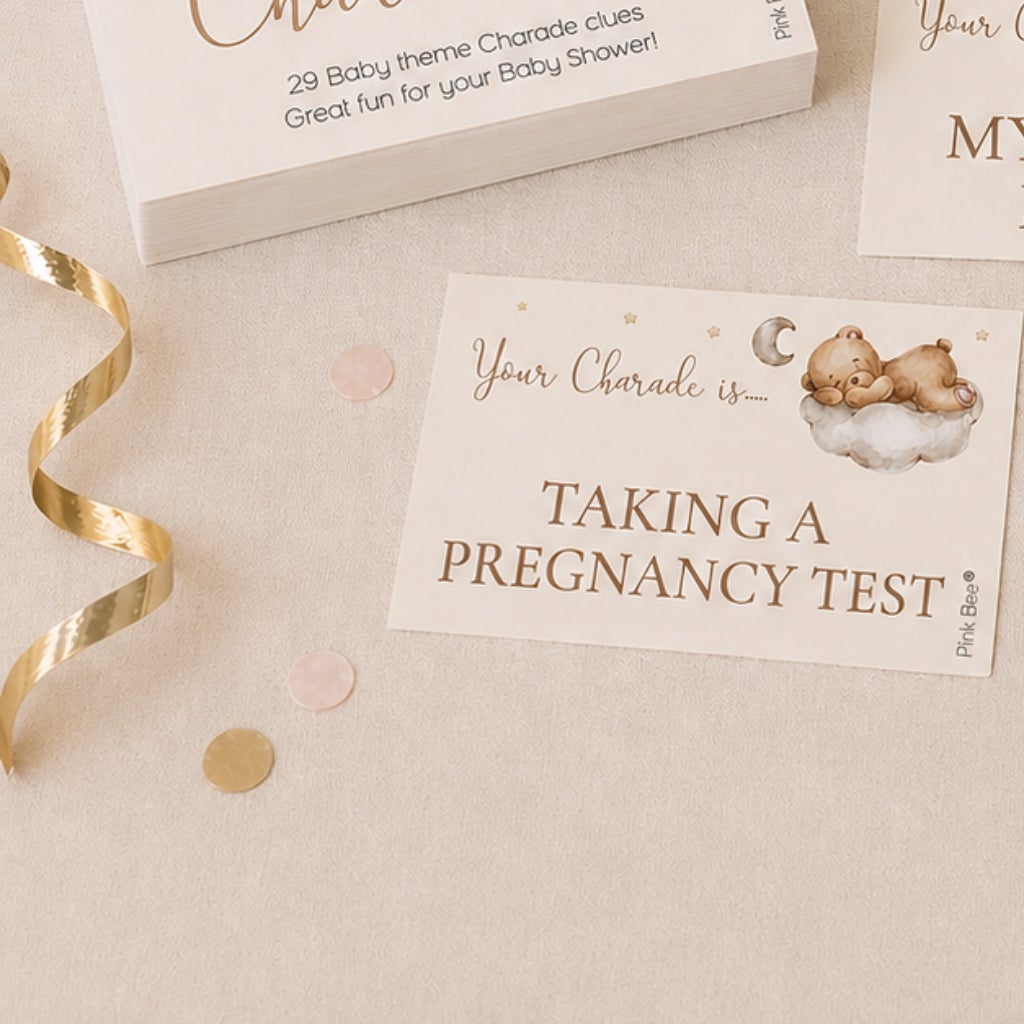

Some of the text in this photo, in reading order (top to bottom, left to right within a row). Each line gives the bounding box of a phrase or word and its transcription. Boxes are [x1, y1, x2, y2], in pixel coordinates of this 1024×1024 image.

[287, 6, 645, 96] 29 Baby theme Charade clues
[769, 5, 792, 41] Pink
[284, 30, 659, 129] Great fun for your Baby Shower!
[472, 337, 558, 402] Your
[571, 347, 705, 398] Charade
[541, 479, 830, 545] TAKING A
[437, 539, 946, 618] PREGNANCY TEST
[956, 622, 976, 658] Pink
